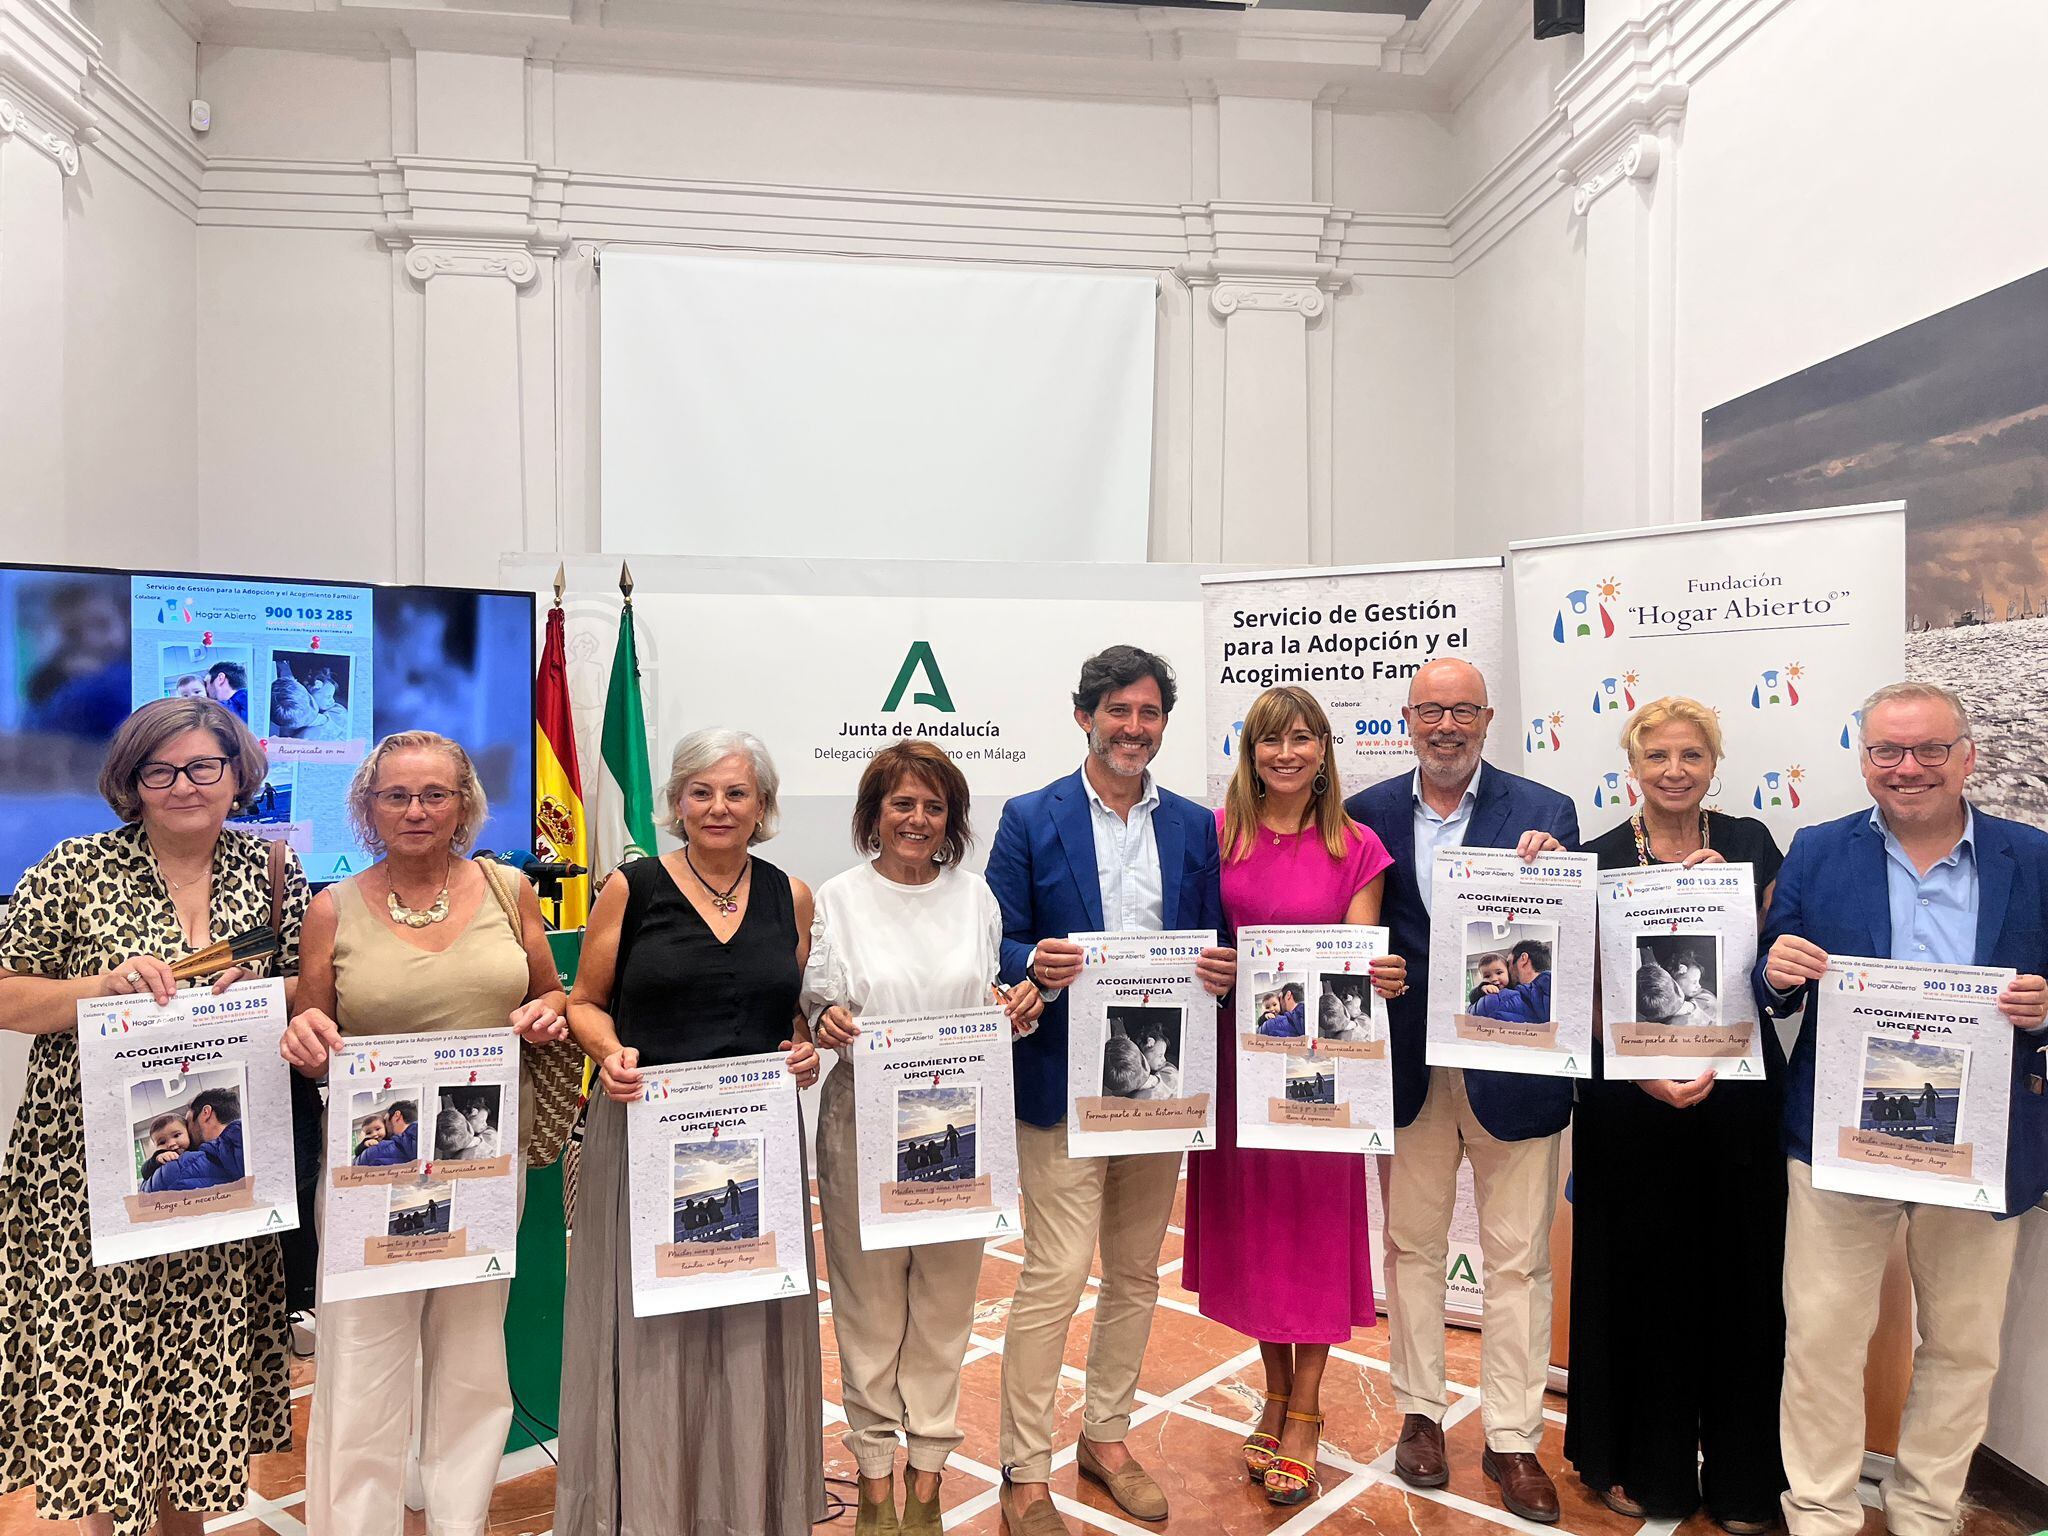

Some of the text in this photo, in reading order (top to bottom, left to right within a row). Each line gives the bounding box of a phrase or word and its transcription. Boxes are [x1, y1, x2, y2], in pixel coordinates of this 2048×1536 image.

[1688, 573, 1782, 593] Fundación
[242, 588, 275, 596] Adopción
[195, 611, 256, 620] Hogar Abierto
[265, 607, 352, 620] 900 103 285
[1233, 600, 1456, 628] Servicio de Gestión
[1224, 628, 1468, 661] para la Adopción y el
[1220, 662, 1364, 687] Acogimiento
[839, 721, 1000, 736] Junta de Andalucía
[1355, 720, 1392, 735] 900
[966, 750, 981, 759] en
[984, 747, 1026, 762] Málaga
[1520, 866, 1582, 877] 900 103 285
[1676, 878, 1695, 886] 900
[1720, 878, 1738, 886] 285
[1457, 893, 1544, 904] ACOGIMIENTO
[1477, 905, 1541, 914] URGENCIA
[1625, 906, 1706, 917] ACOGIMIENTO
[1643, 917, 1704, 926] URGENCIA
[1150, 948, 1167, 956] 900
[1170, 947, 1186, 955] 103
[1316, 941, 1333, 949] 900
[1336, 941, 1353, 949] 103
[1097, 977, 1175, 985] ACOGIMIENTO
[1868, 982, 1917, 991] Hogar Abierto
[1923, 980, 1998, 995] 900 103 285
[192, 998, 268, 1015] 900 103 285
[132, 1018, 155, 1027] Hogar
[1852, 1007, 1979, 1025] ACOGIMIENTO DE
[939, 1023, 997, 1035] 900 103 285
[1877, 1021, 1952, 1034] URGENCIA
[114, 1035, 249, 1059] ACOGIMIENTO DE
[1621, 1036, 1642, 1044] Forma
[1645, 1035, 1665, 1047] parte
[434, 1046, 504, 1059] 900 103 285
[142, 1051, 223, 1068] URGENCIA
[883, 1057, 966, 1070] ACOGIMIENTO
[718, 1070, 781, 1085] 900 103 285
[904, 1068, 965, 1080] URGENCIA
[671, 1083, 713, 1094] Hogar Abierto
[659, 1104, 768, 1123] ACOGIMIENTO DE
[1086, 1111, 1108, 1119] Forma
[1110, 1109, 1129, 1121] parte
[1133, 1109, 1141, 1117] de
[681, 1118, 746, 1132] URGENCIA
[183, 1198, 191, 1206] te
[195, 1192, 231, 1203] necesitan
